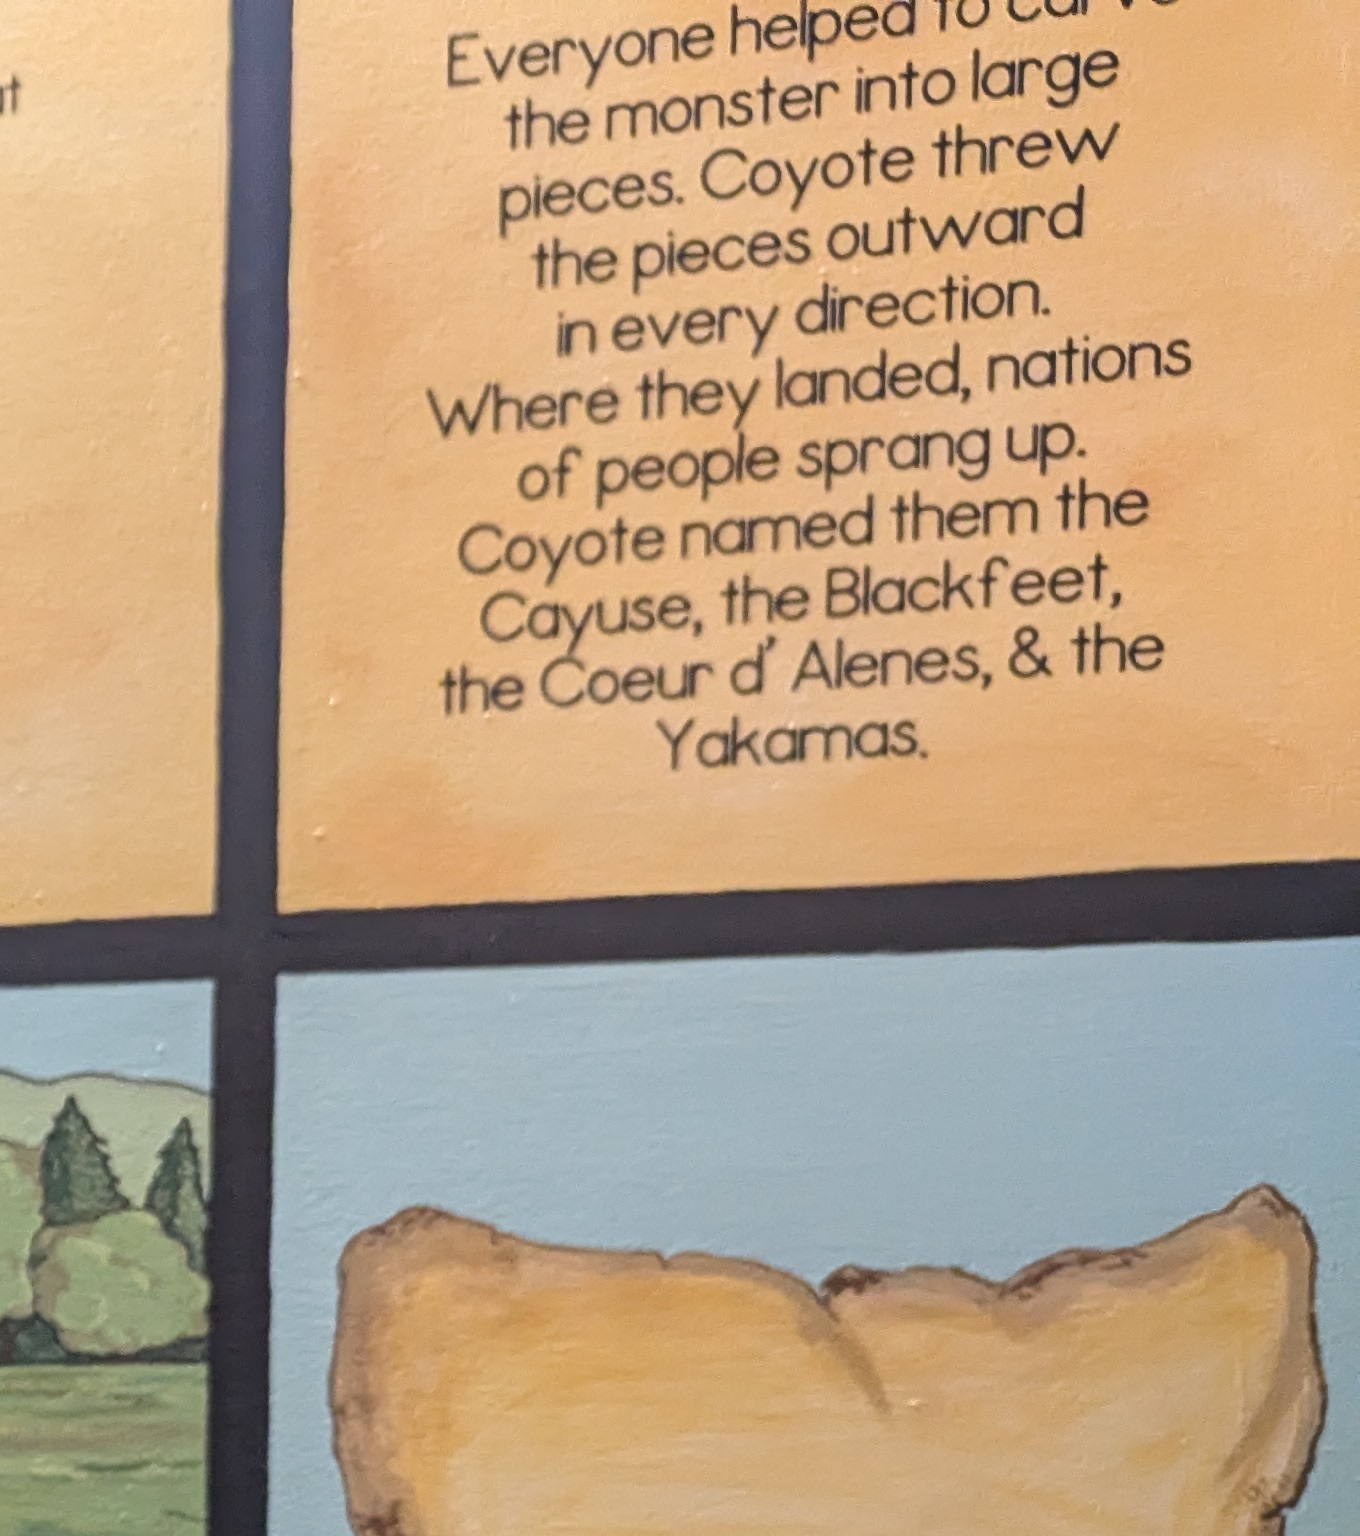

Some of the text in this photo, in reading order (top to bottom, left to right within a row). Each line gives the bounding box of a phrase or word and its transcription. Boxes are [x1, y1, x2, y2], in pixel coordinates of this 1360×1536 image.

[448, 0, 990, 89] Everyone helped to
[504, 48, 1120, 150] the monster into large
[499, 122, 1120, 239] pieces. Coyote threw
[531, 184, 1085, 295] the pieces outward
[557, 275, 1050, 358] in every direction.
[427, 335, 1192, 438] Where they landed, nations
[518, 422, 1086, 510] of people sprang up.
[458, 477, 1149, 587] Coyote named them the
[480, 553, 1121, 654] Cayuse, the Blackfeet,
[440, 665, 525, 715] the
[539, 655, 716, 707] Coeur
[791, 638, 992, 692] Alenes,
[1008, 625, 1053, 678] &
[1070, 622, 1165, 675] the
[657, 716, 928, 770] Yakamas.
